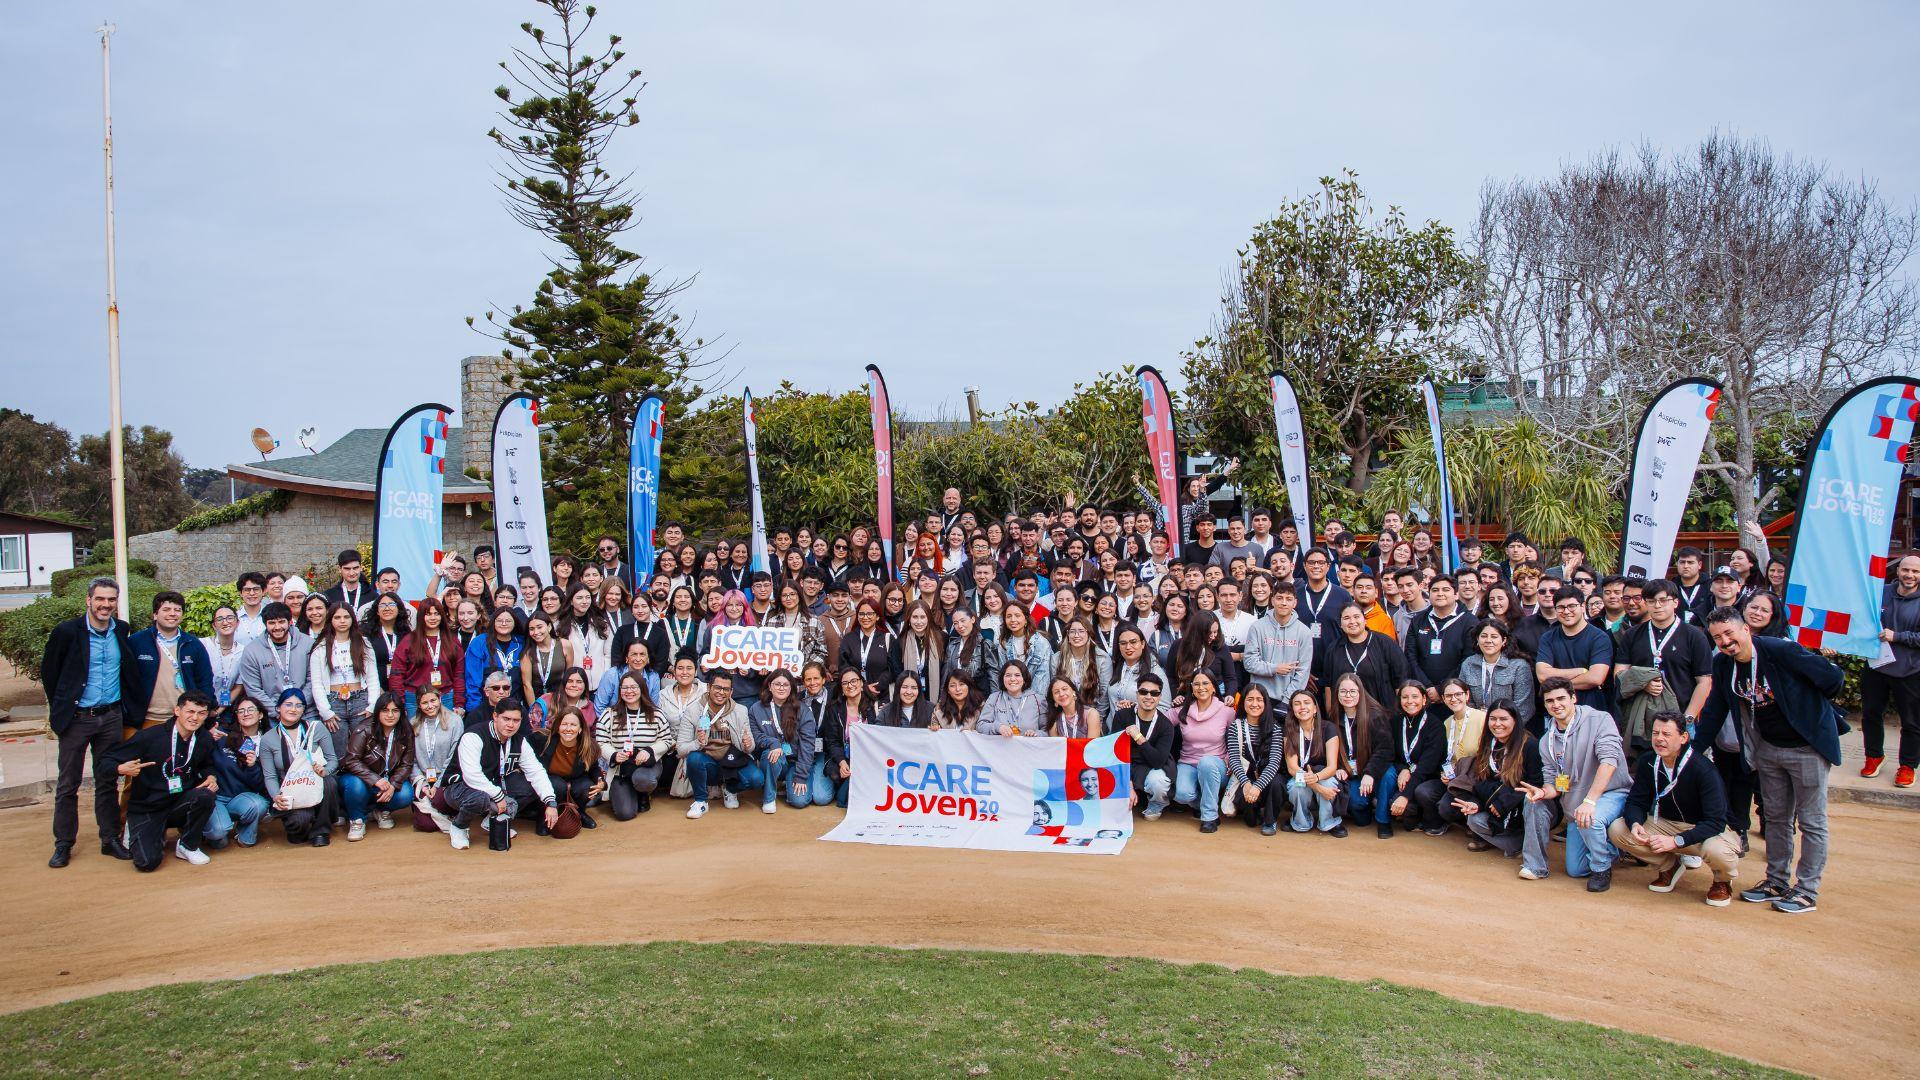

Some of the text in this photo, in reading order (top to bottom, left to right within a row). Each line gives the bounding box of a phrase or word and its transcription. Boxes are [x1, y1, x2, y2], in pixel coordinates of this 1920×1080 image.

[1818, 477, 1883, 506] iCARE
[383, 505, 433, 524] Joven
[1808, 494, 1873, 523] Joven
[716, 629, 794, 651] iCARE
[706, 646, 800, 670] Joven 20
[886, 758, 992, 796] iCARE
[874, 784, 1000, 821] Joven 20
